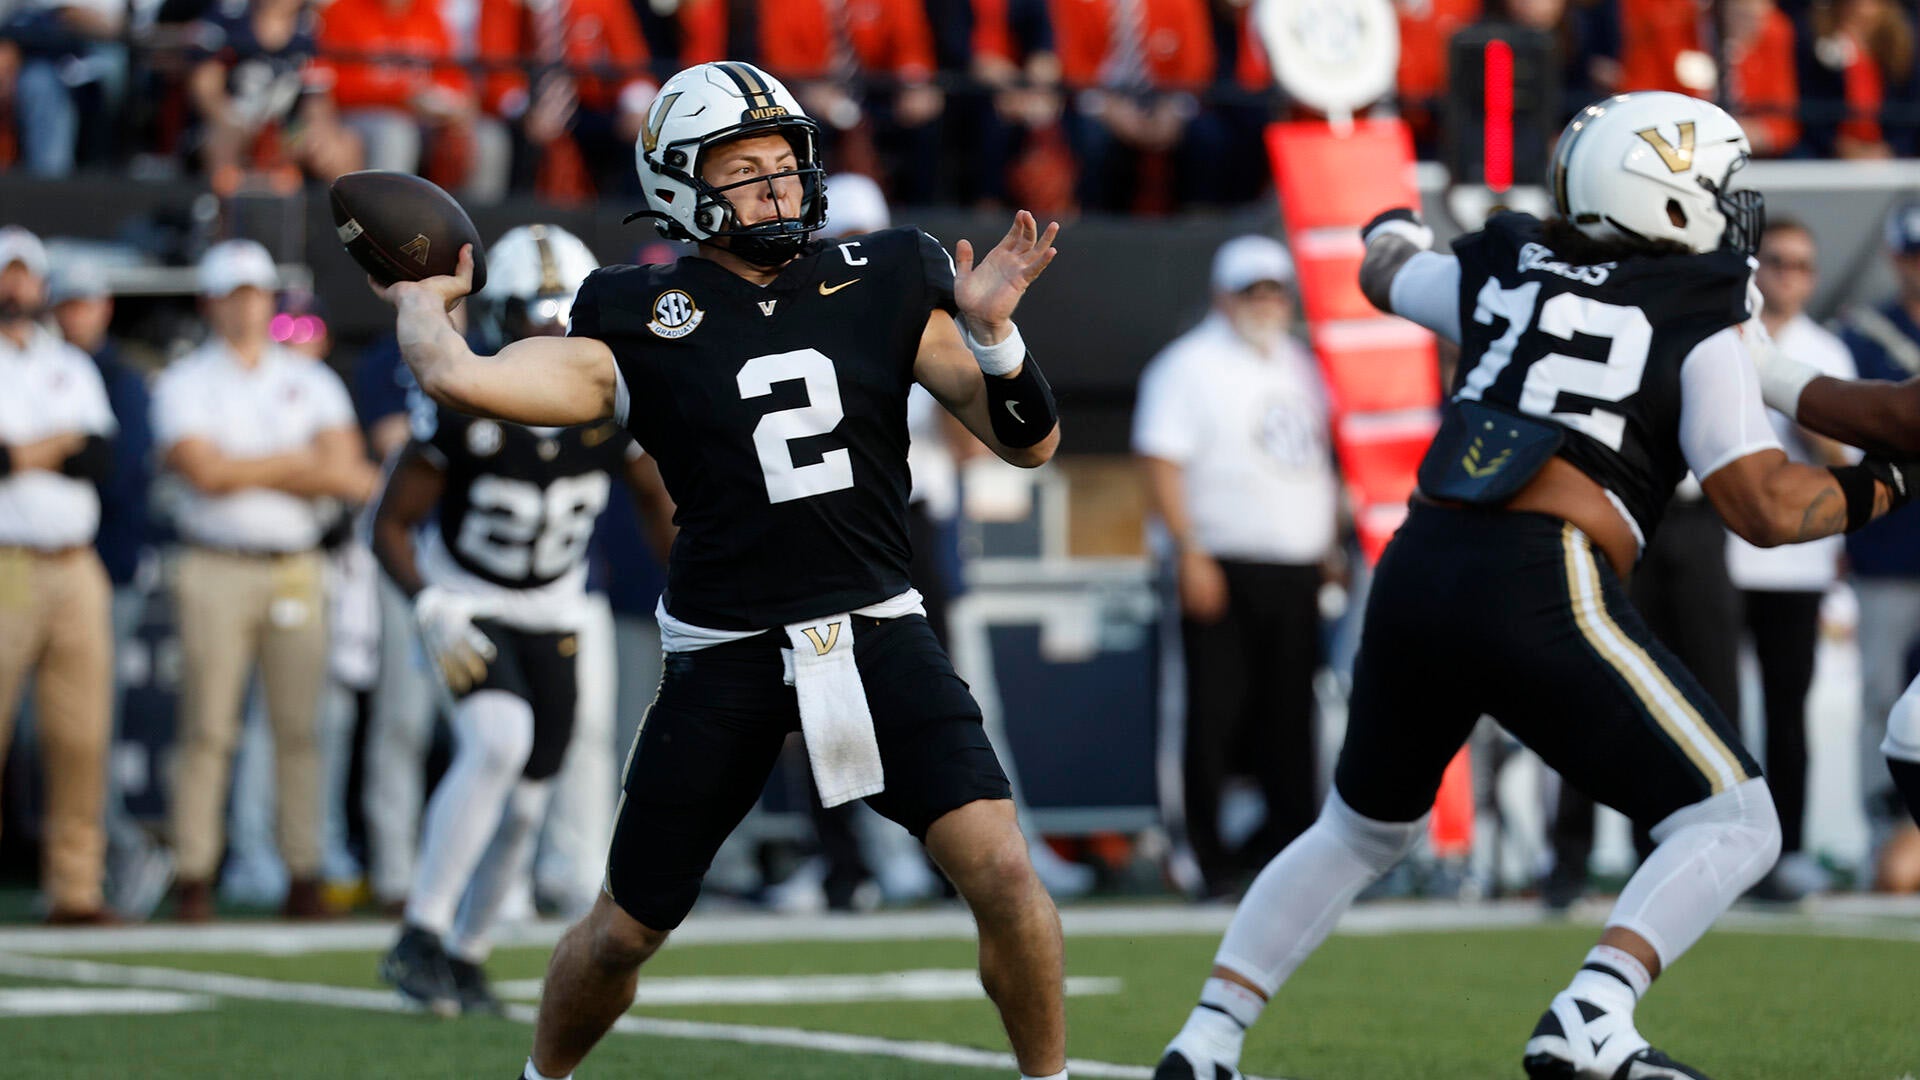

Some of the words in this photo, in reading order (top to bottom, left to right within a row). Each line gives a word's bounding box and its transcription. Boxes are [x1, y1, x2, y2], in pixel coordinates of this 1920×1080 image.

[1635, 121, 1696, 174] V
[838, 241, 868, 266] C
[656, 292, 692, 326] SEC
[758, 299, 777, 316] V
[655, 319, 697, 337] GRADUATE
[1452, 276, 1652, 451] 72
[736, 348, 854, 504] 2
[802, 622, 841, 656] V
